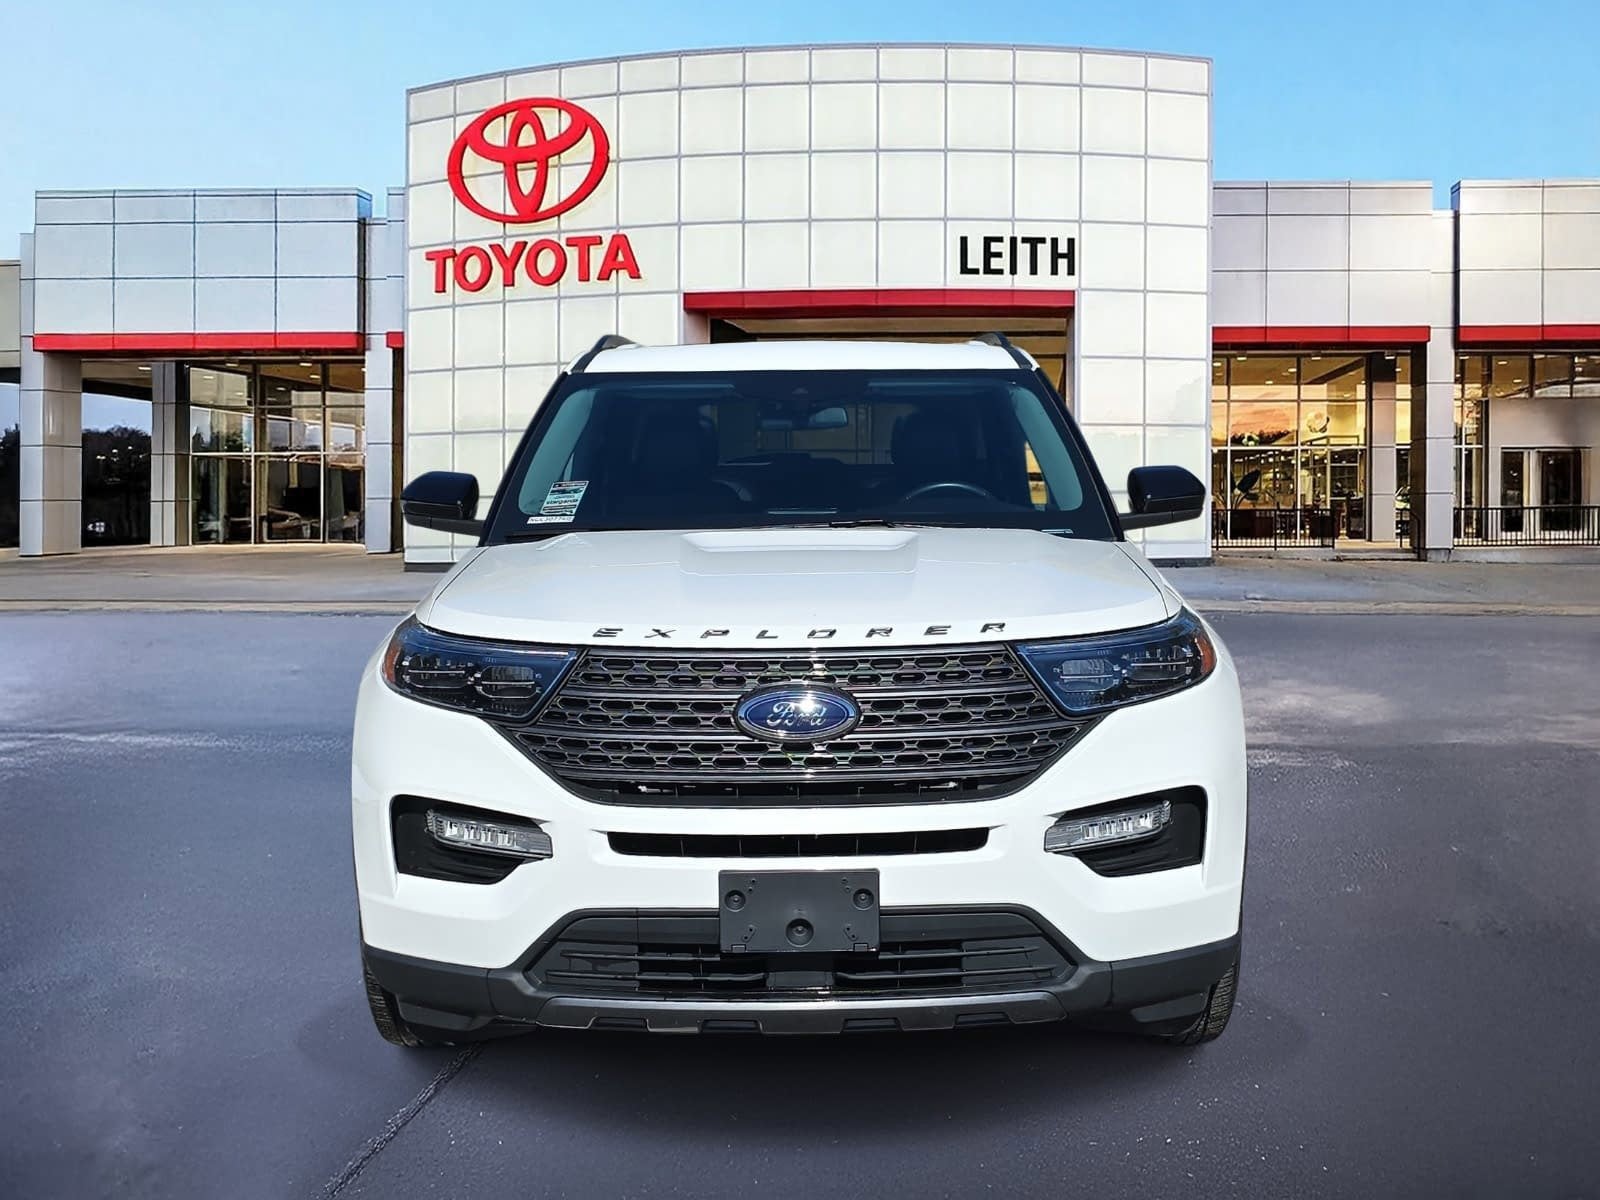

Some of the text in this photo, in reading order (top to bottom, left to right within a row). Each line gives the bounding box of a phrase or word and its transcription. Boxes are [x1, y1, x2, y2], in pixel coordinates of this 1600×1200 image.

[425, 234, 641, 293] TOYOTA
[960, 236, 1075, 275] LEITH
[593, 622, 1006, 639] EXPLORER
